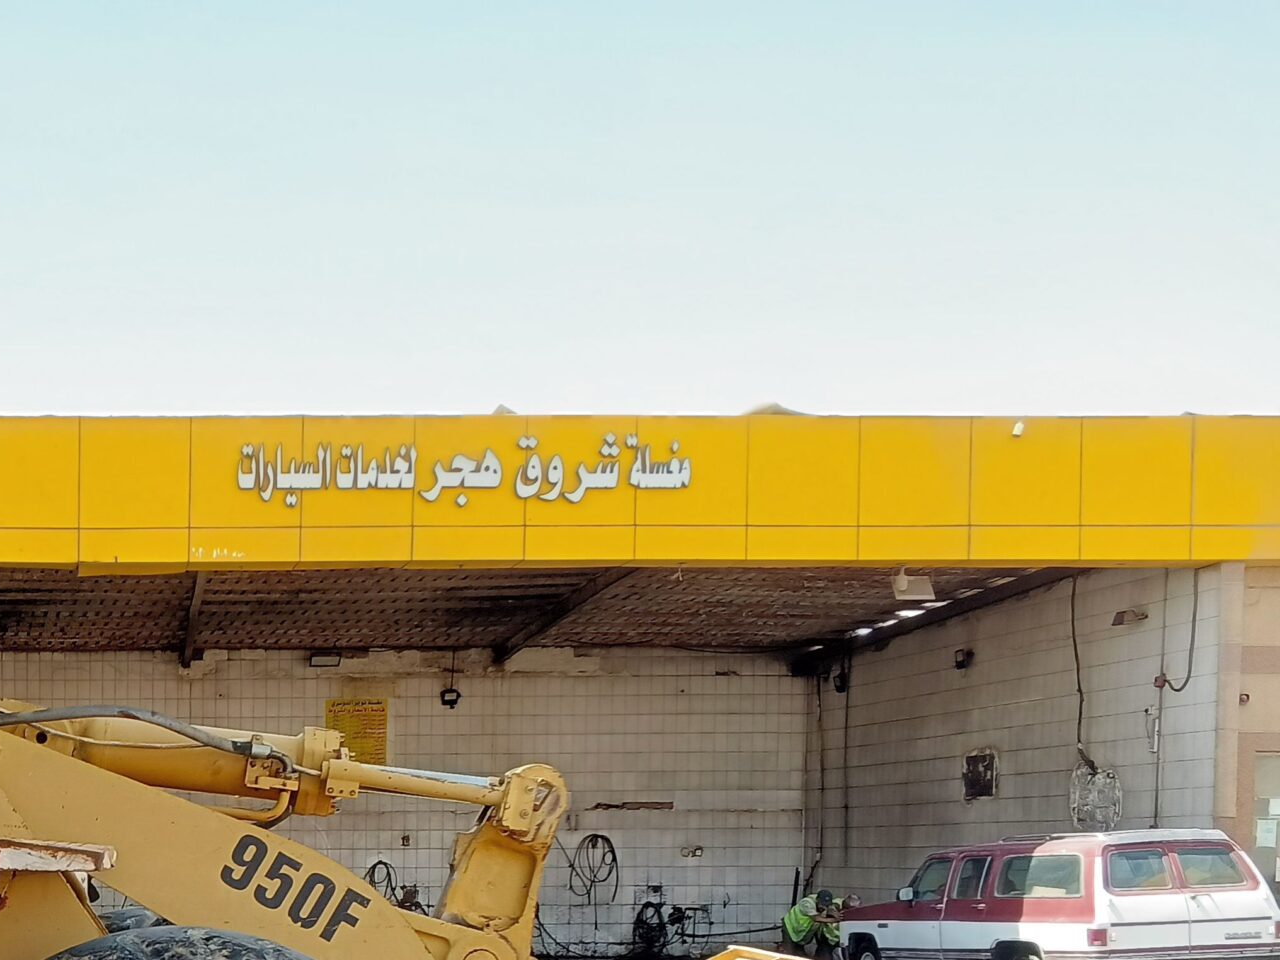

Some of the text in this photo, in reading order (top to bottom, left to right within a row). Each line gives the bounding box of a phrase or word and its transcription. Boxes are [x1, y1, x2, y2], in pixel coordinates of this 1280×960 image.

[236, 431, 692, 508] مغسلة شروق هجر لخدمات السيارات
[220, 833, 372, 942] 950F
